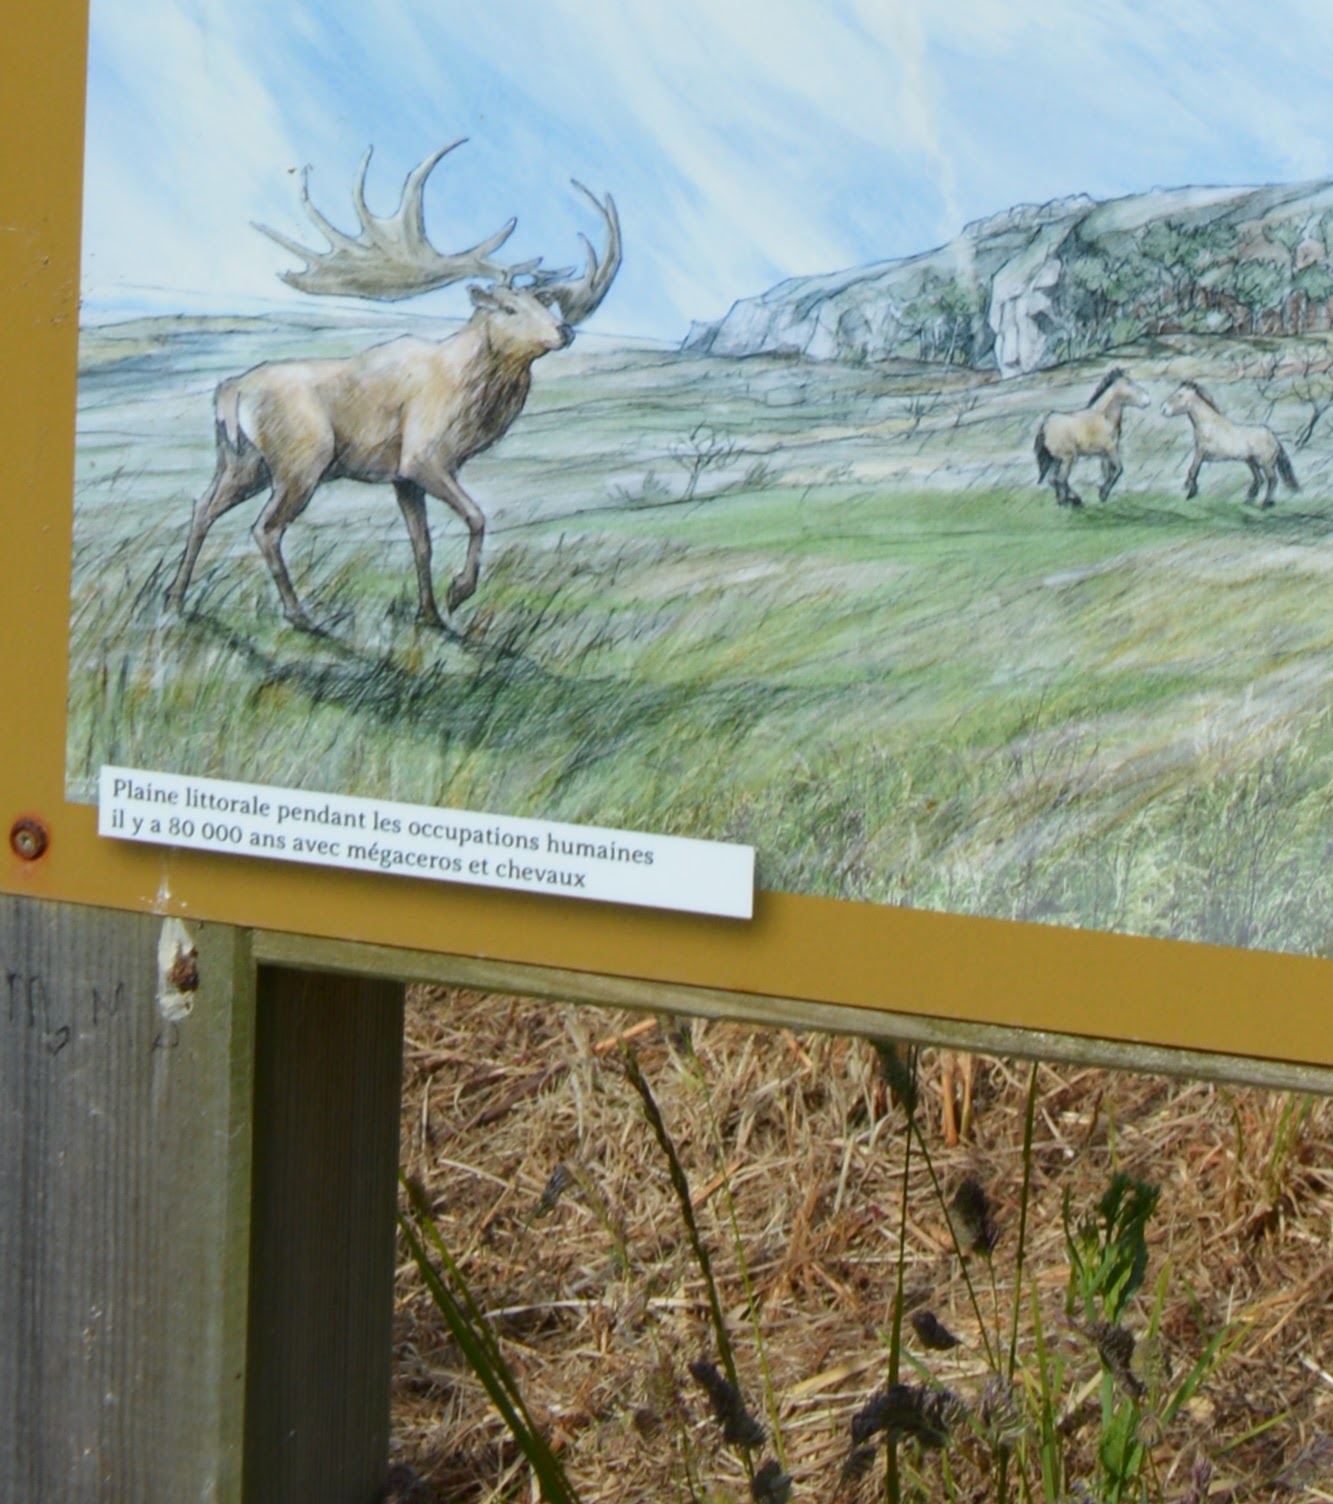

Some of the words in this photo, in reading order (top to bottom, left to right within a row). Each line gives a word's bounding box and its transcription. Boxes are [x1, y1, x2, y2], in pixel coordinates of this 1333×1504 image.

[112, 809, 124, 829] il
[133, 818, 143, 835] y
[150, 820, 161, 833] a
[169, 817, 195, 837] 80
[201, 823, 243, 843] 000
[249, 832, 286, 849] ans
[293, 838, 340, 856] avec
[347, 842, 462, 872] mégaceros
[468, 859, 488, 875] et
[495, 859, 585, 888] chevaux
[113, 779, 178, 805] Plaine
[186, 787, 270, 817] littorale
[277, 805, 365, 829] pendant
[373, 811, 401, 833] les
[408, 822, 539, 851] occupations
[547, 833, 654, 865] humaines
